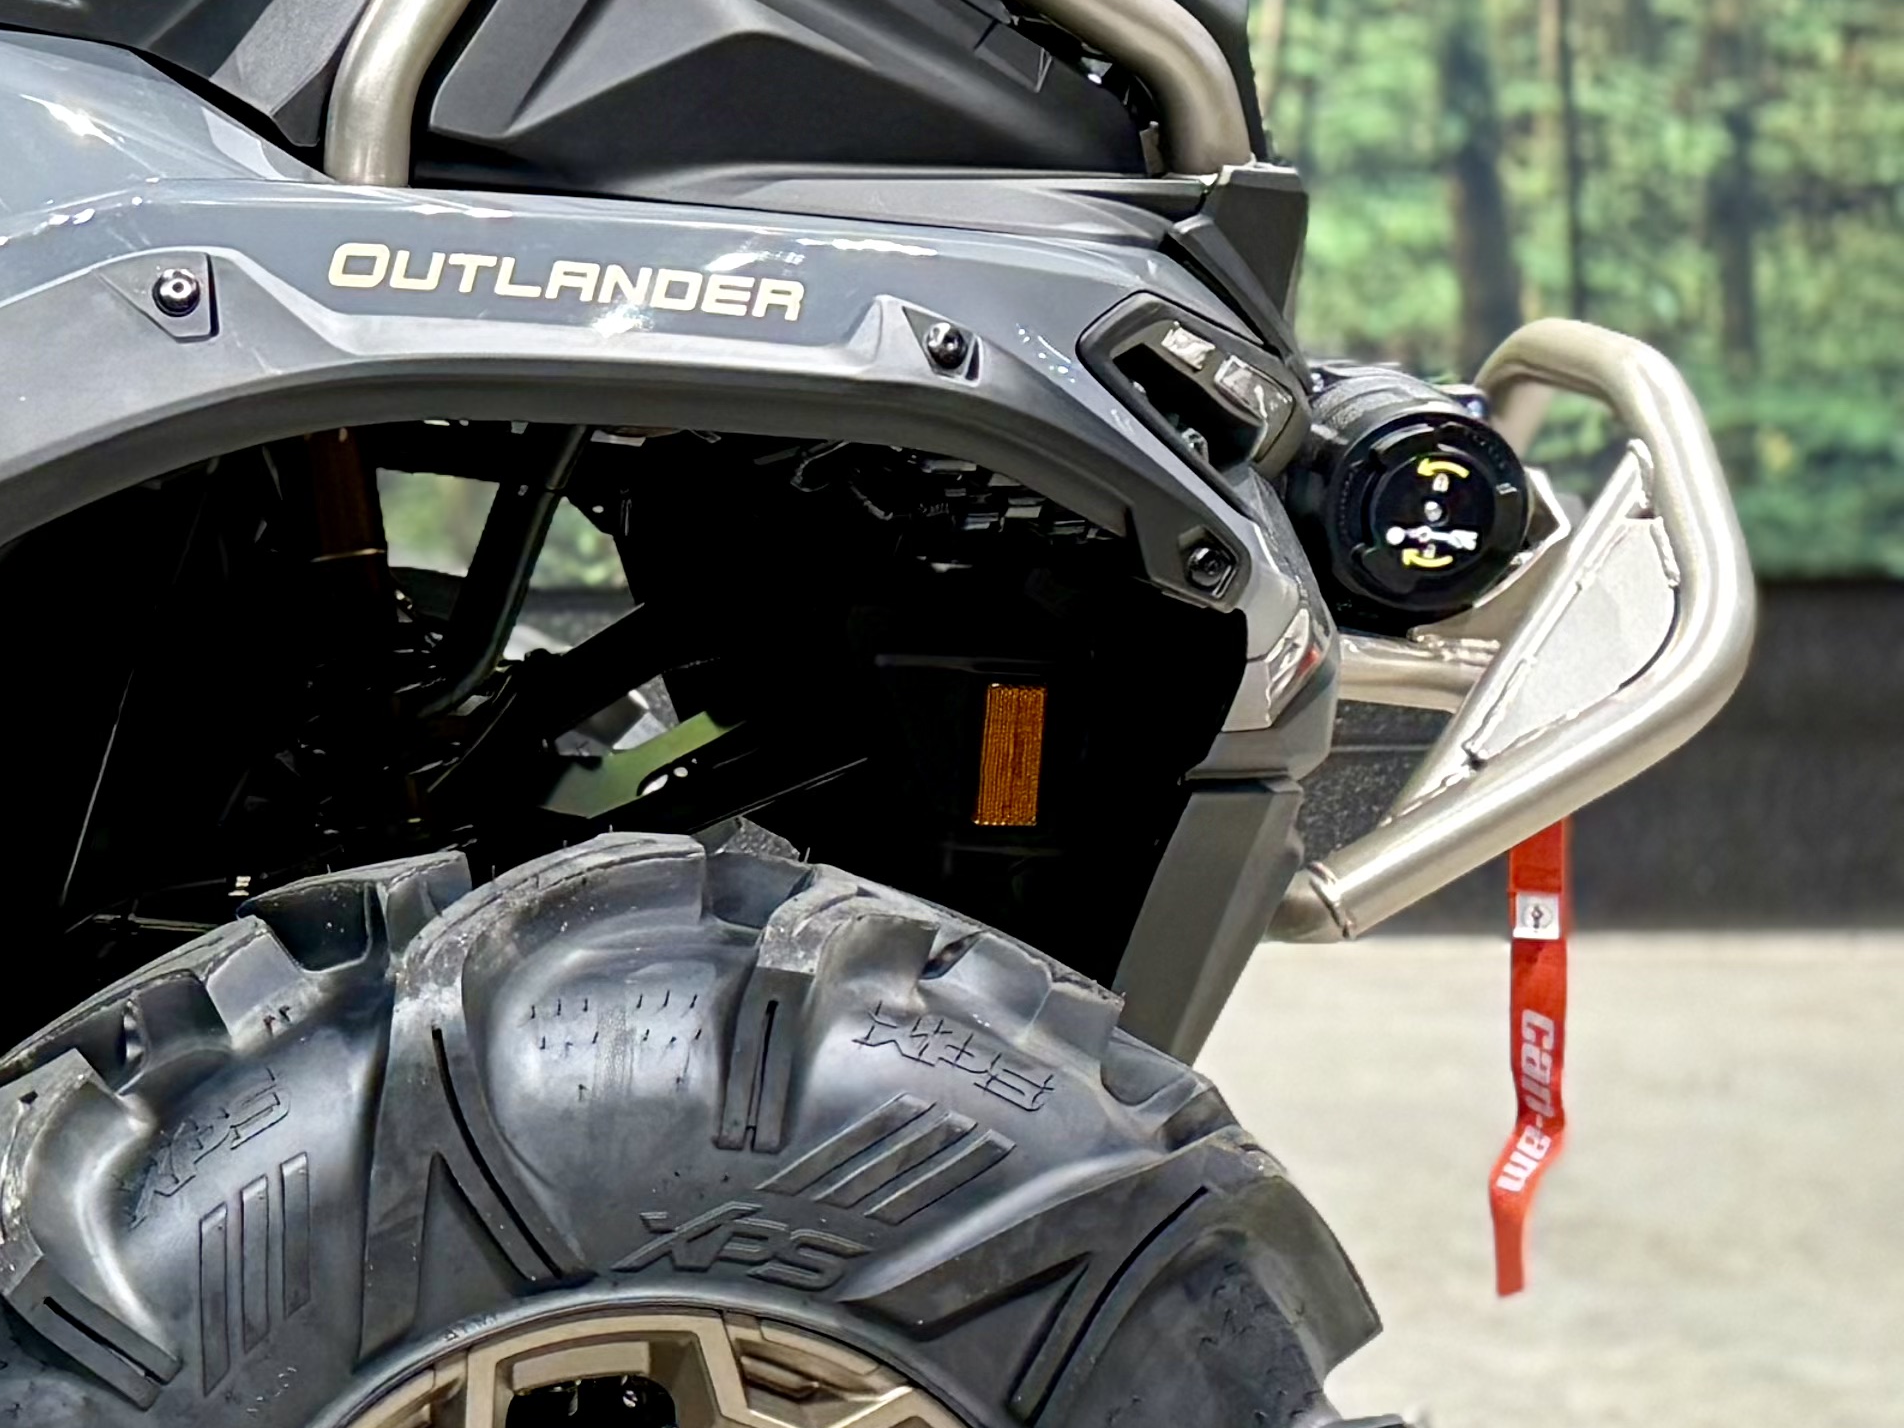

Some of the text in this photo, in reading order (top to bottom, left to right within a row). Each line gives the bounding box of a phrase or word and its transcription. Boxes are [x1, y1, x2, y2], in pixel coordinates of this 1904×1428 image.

[328, 242, 805, 321] OUTLANDER
[1495, 1009, 1556, 1193] can-am
[610, 1200, 872, 1292] XPS
